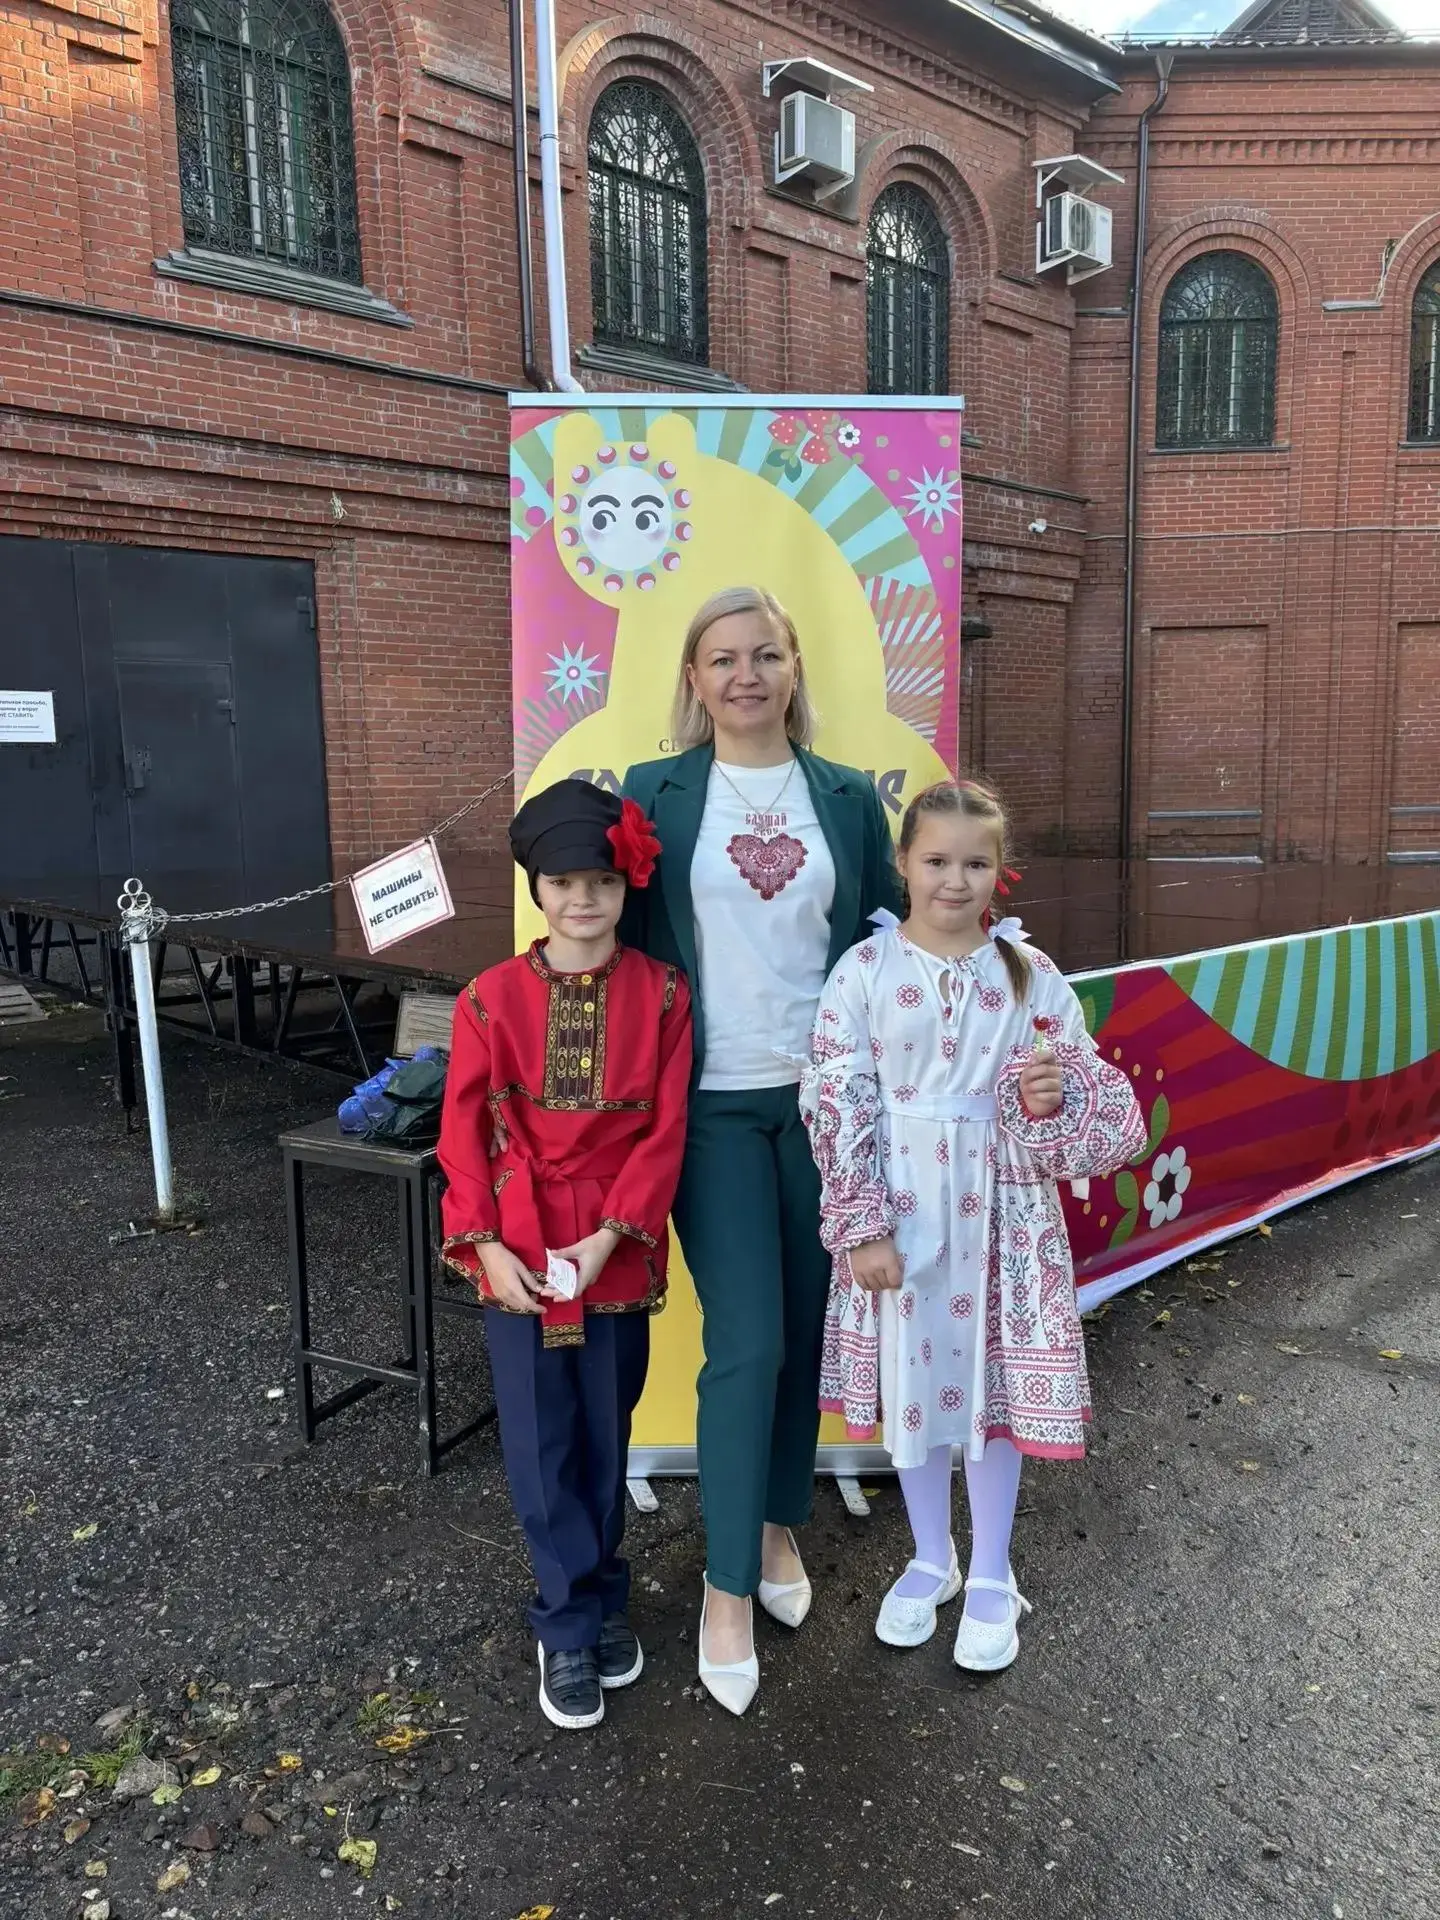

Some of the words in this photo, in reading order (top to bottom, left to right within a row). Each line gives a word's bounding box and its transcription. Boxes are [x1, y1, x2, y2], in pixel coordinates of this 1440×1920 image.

[371, 869, 423, 902] МАШИНЫ
[369, 913, 384, 927] НЕ
[385, 886, 439, 919] СТАВИТЬ!
